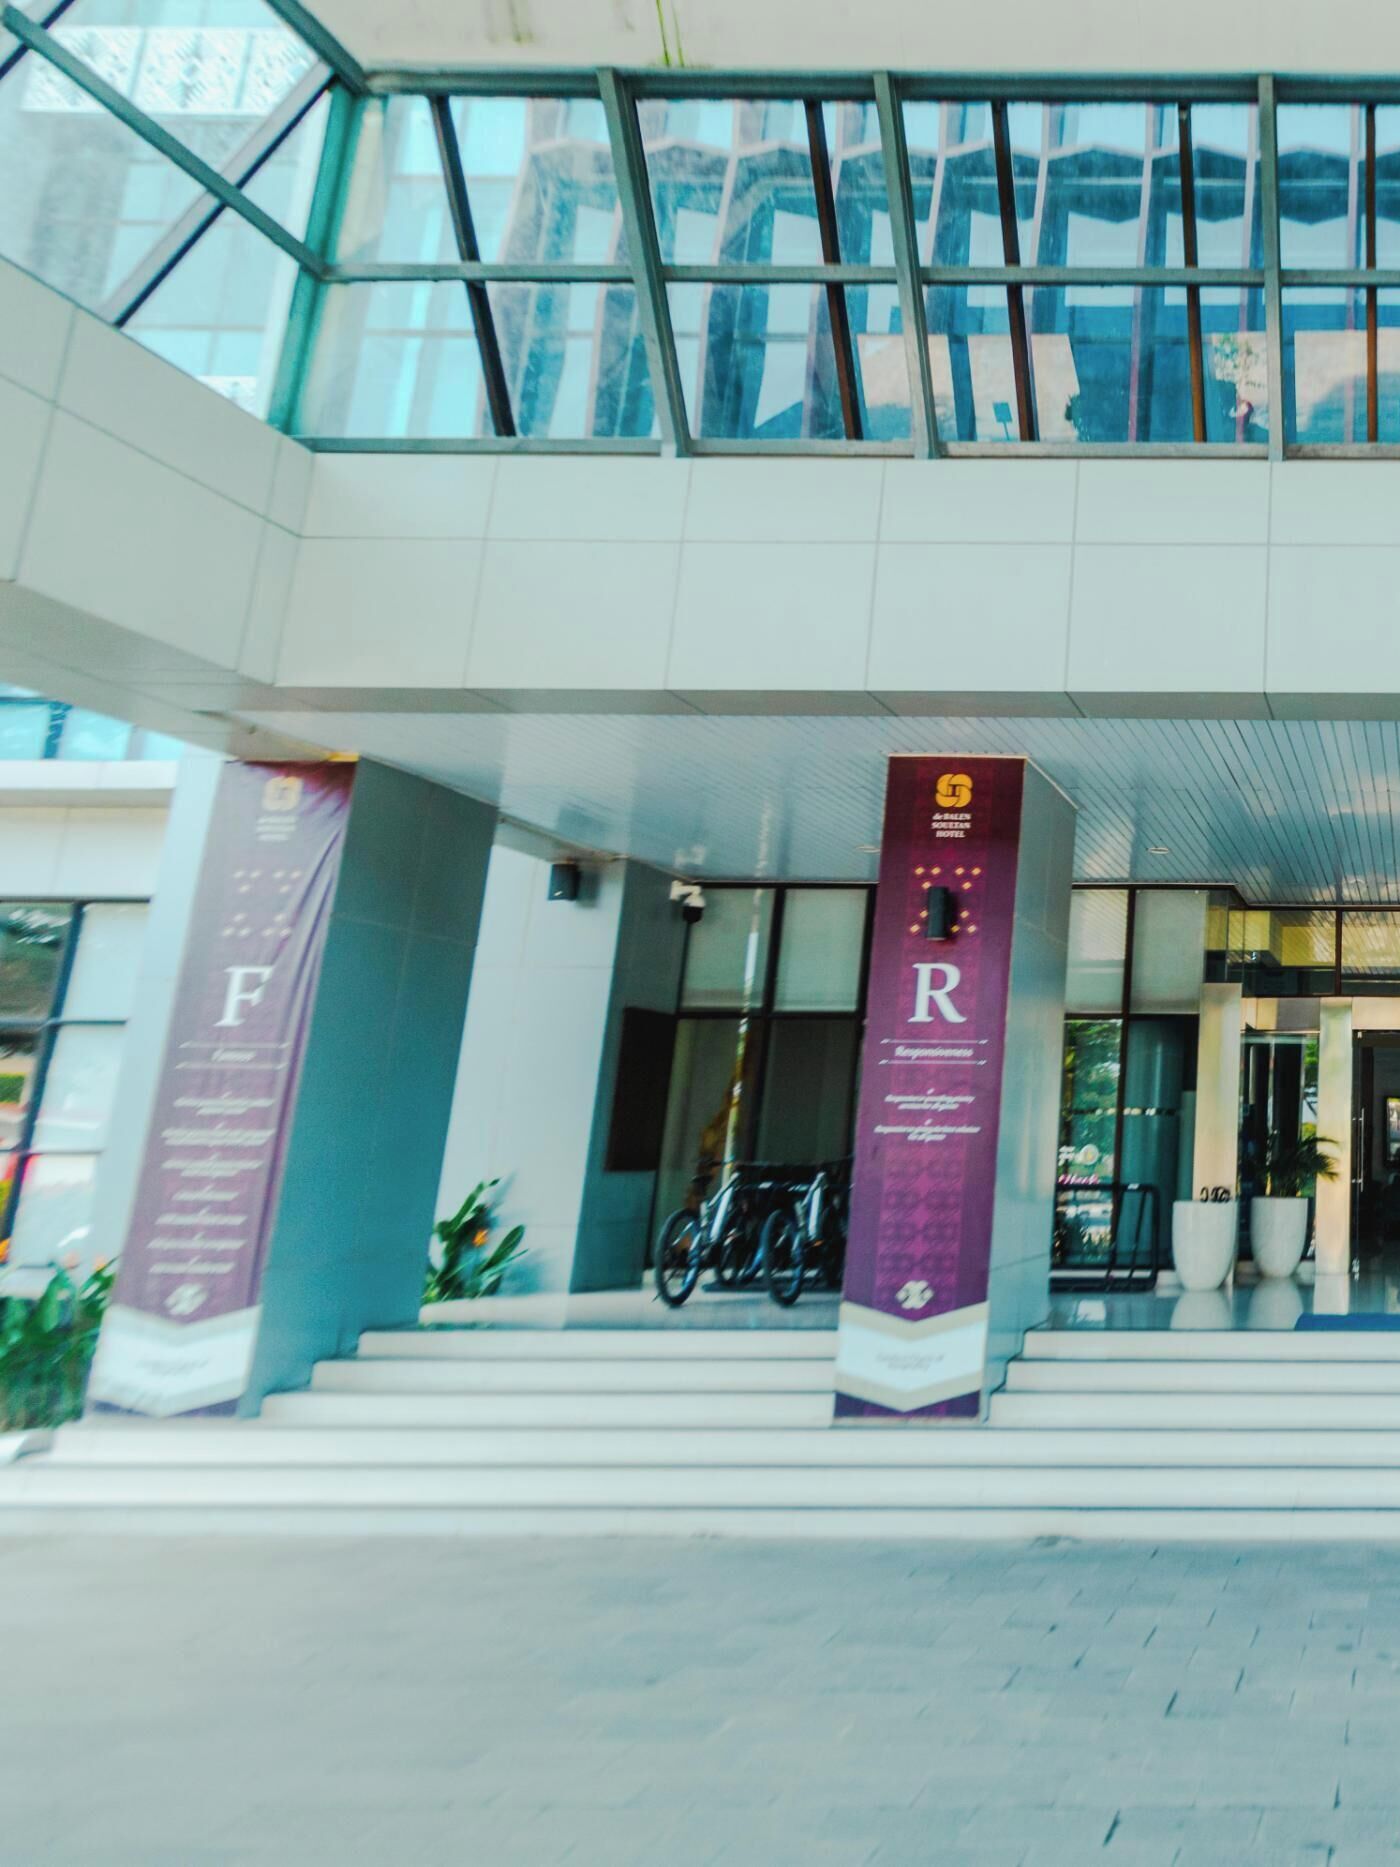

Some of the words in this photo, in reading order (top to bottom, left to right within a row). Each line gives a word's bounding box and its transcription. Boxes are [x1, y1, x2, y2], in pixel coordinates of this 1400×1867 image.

[936, 830, 966, 838] HOTEL
[213, 965, 274, 1027] F
[907, 962, 968, 1024] R
